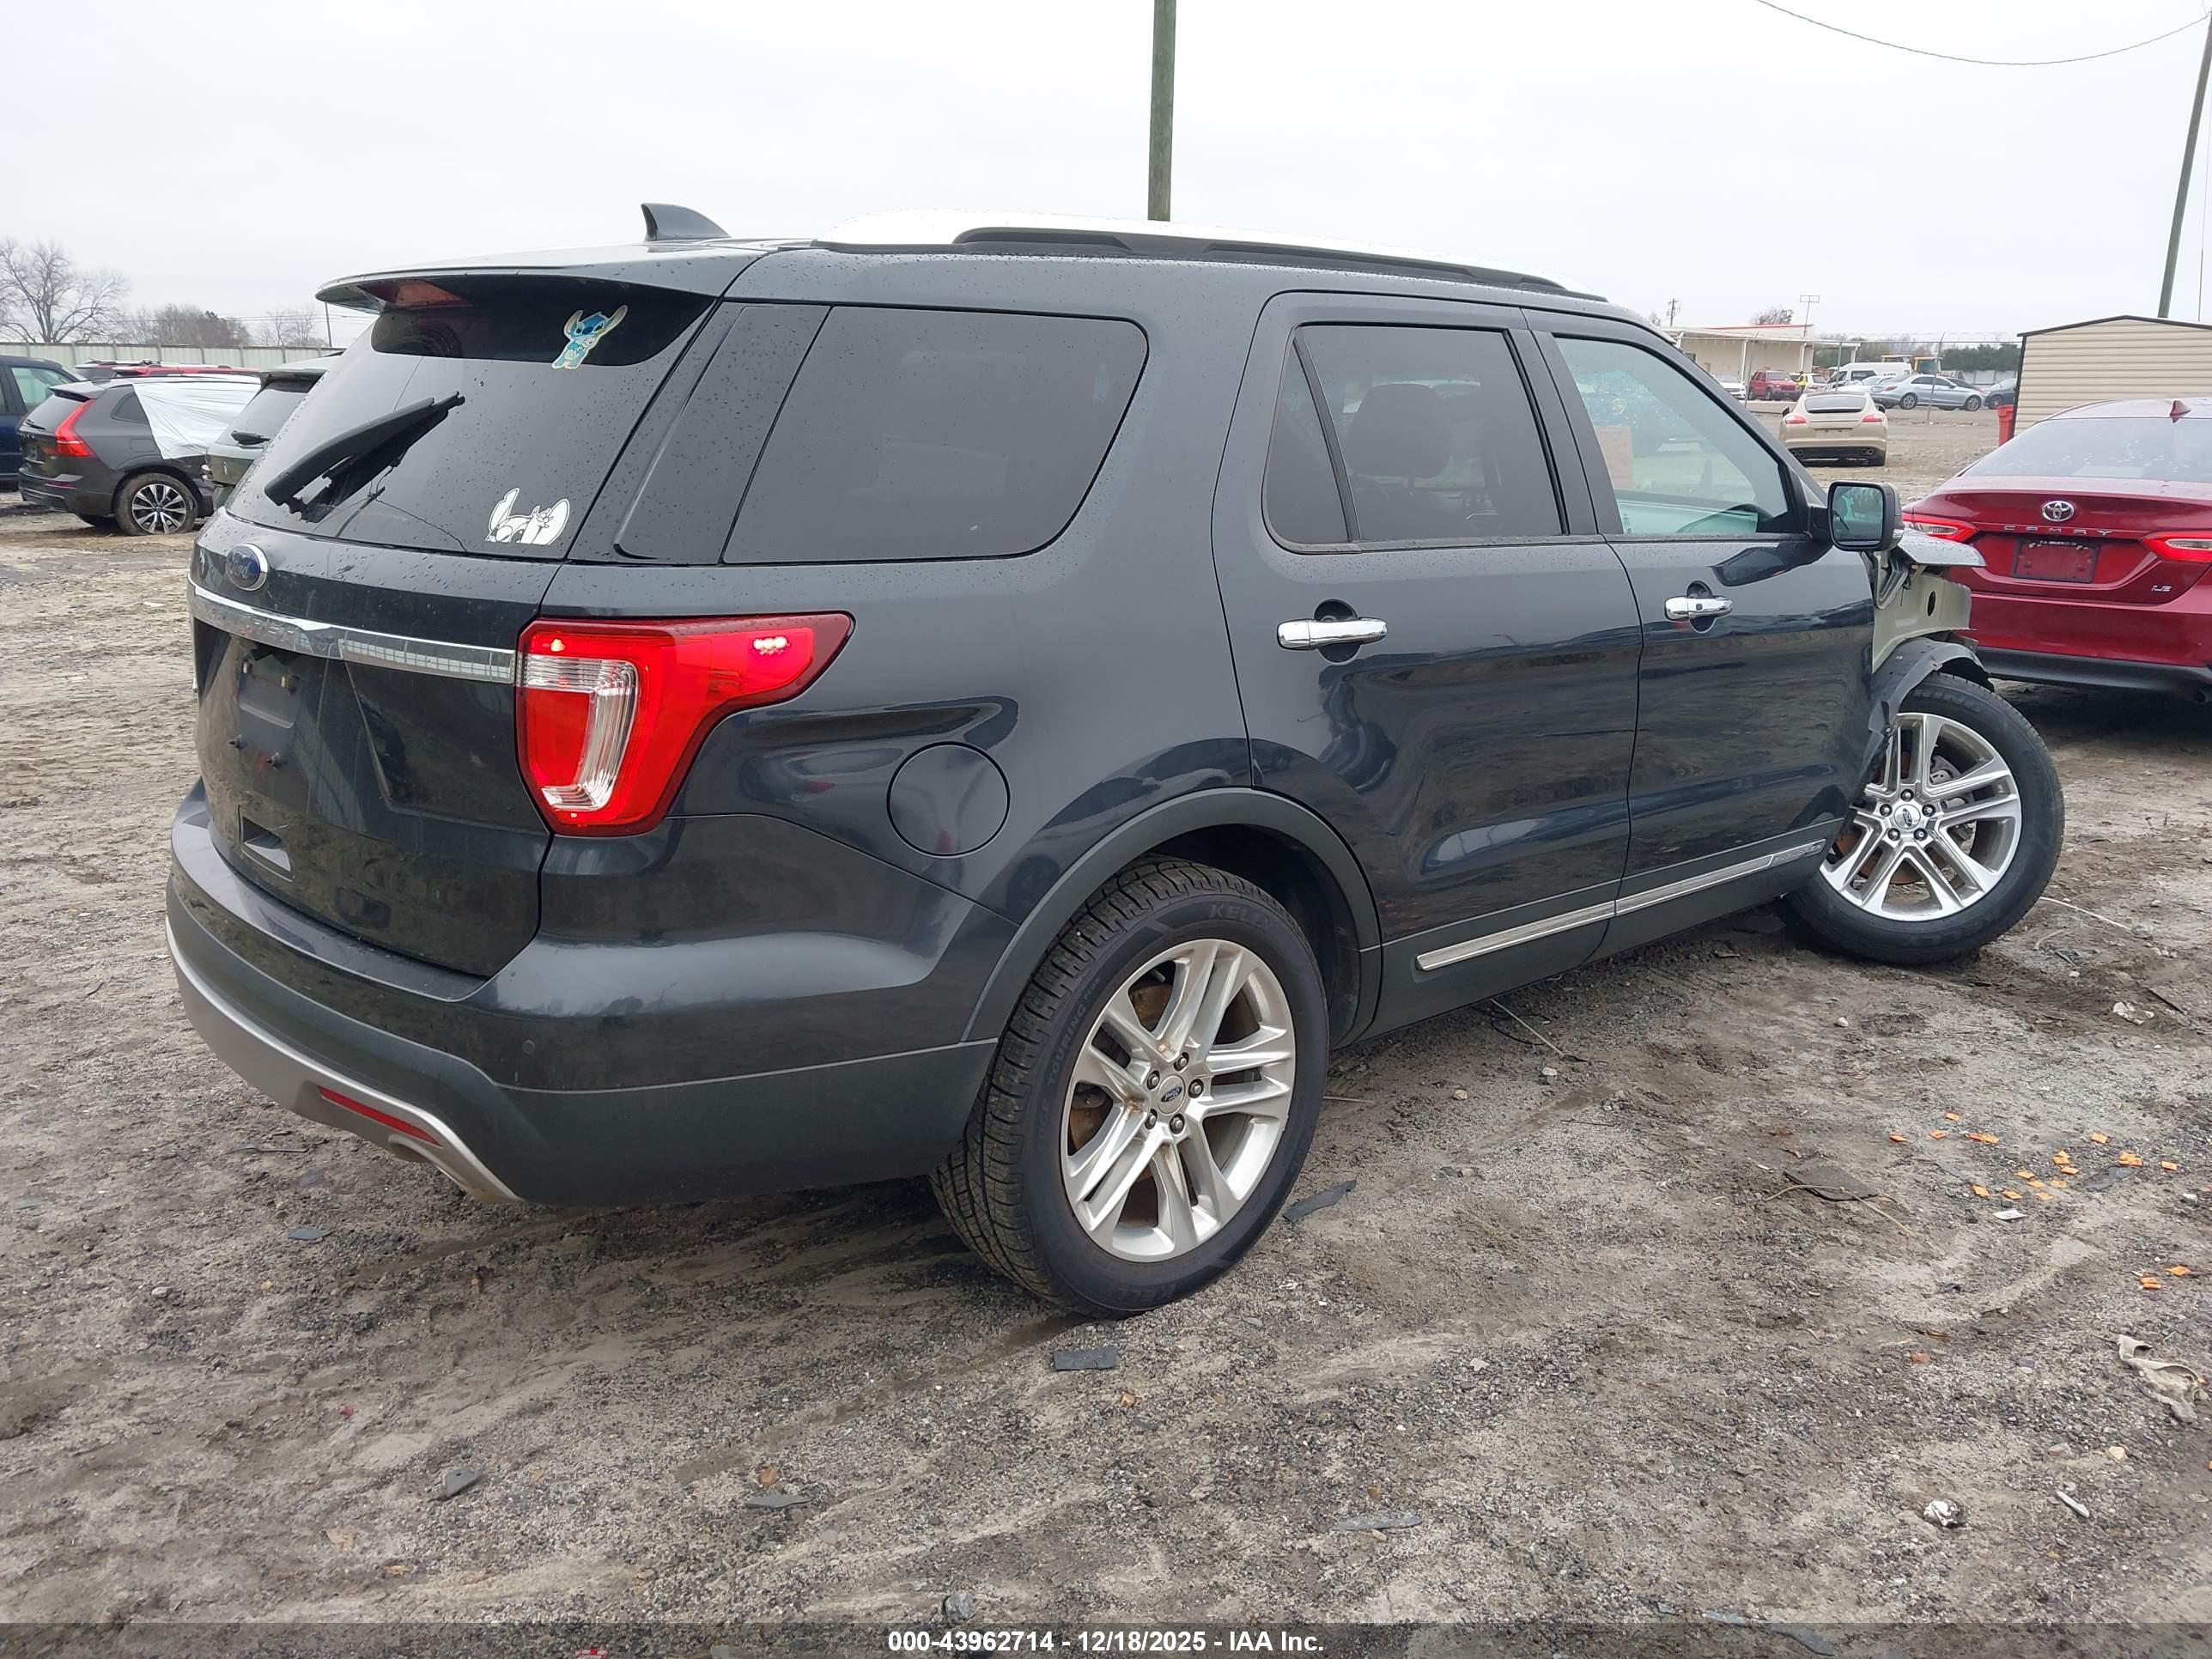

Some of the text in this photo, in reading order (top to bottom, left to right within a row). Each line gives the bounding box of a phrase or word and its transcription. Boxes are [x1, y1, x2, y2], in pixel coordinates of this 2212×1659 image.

[2004, 524, 2113, 536] CAMRY
[1209, 903, 1276, 929] KELLY
[1046, 1003, 1086, 1086] TOURING
